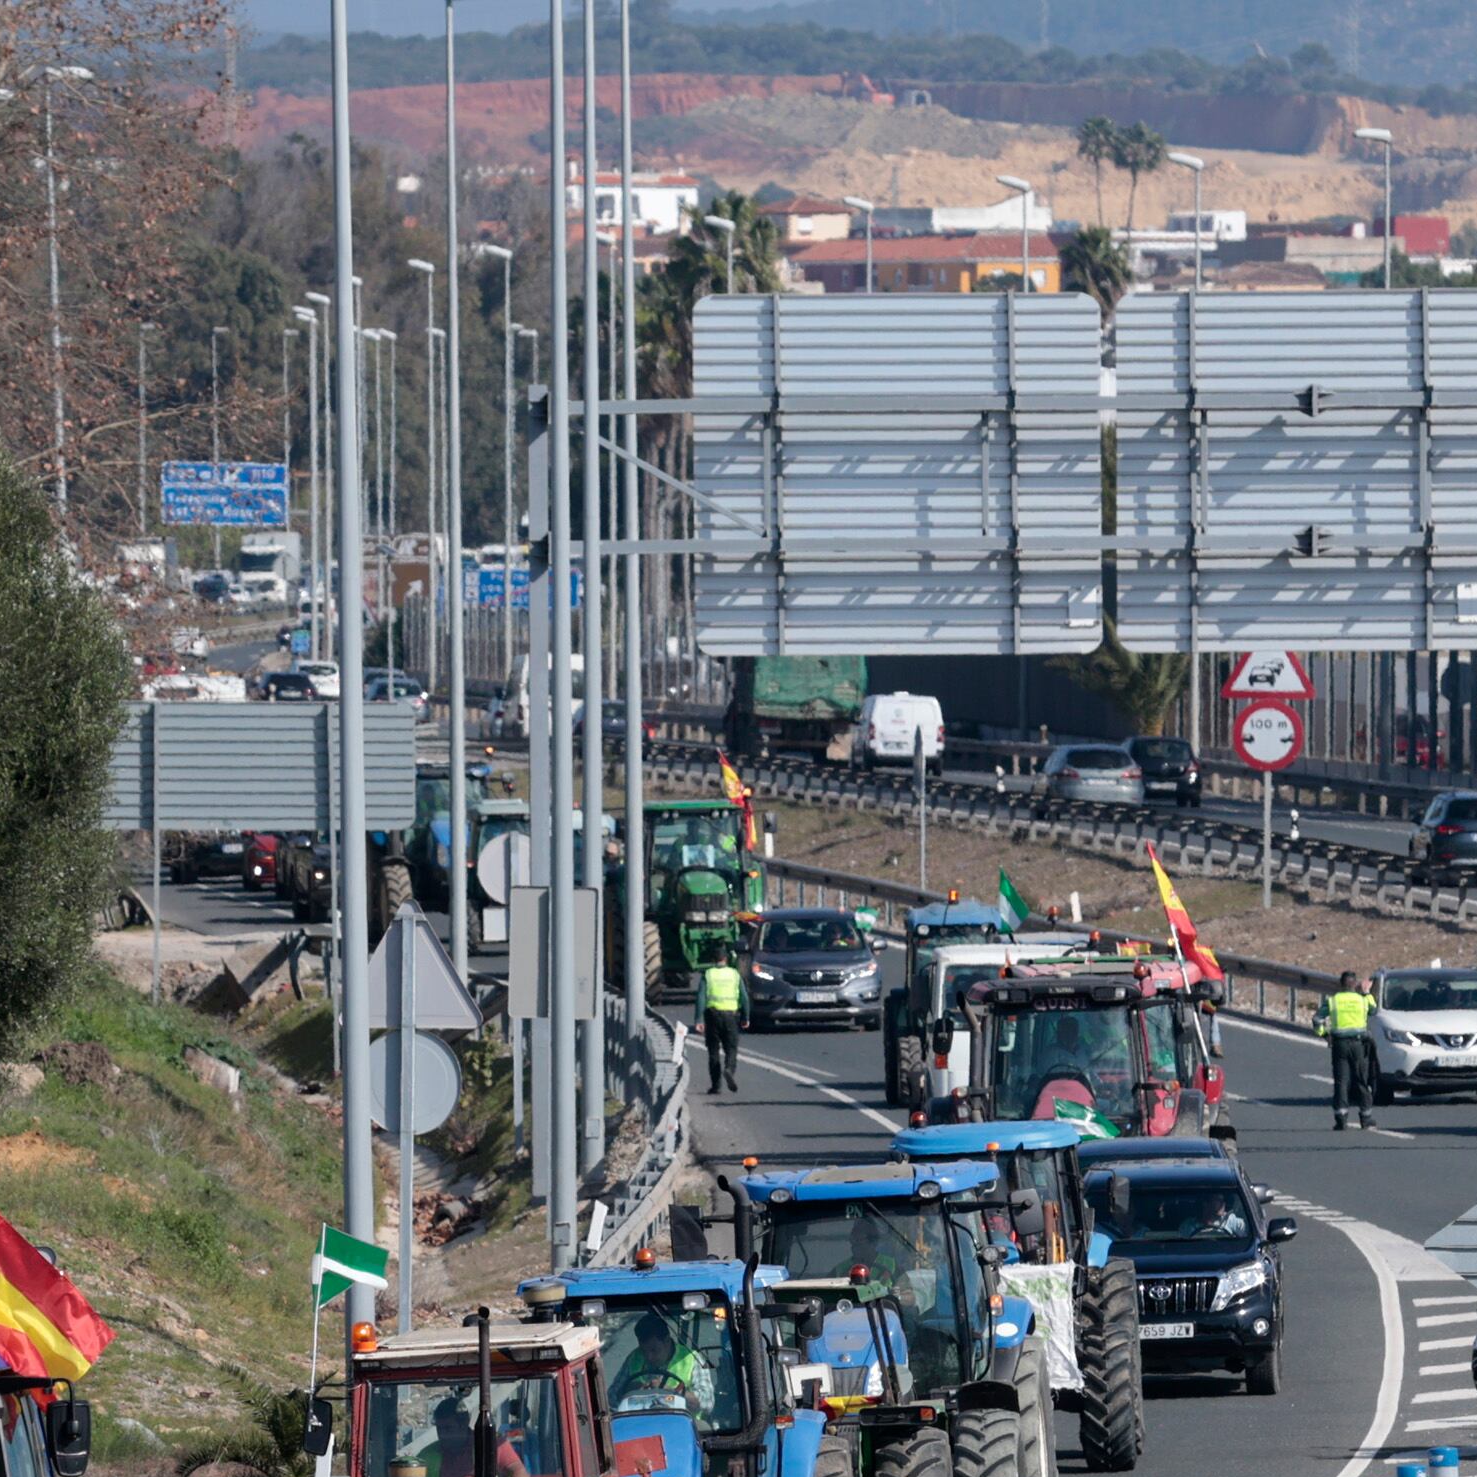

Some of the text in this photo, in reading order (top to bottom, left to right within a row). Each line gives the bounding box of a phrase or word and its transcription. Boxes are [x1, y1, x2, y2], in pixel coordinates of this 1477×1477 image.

[1250, 719, 1287, 729] 100 m
[1034, 998, 1088, 1011] QUINI
[845, 1204, 863, 1219] PN
[1138, 1326, 1166, 1337] 7659
